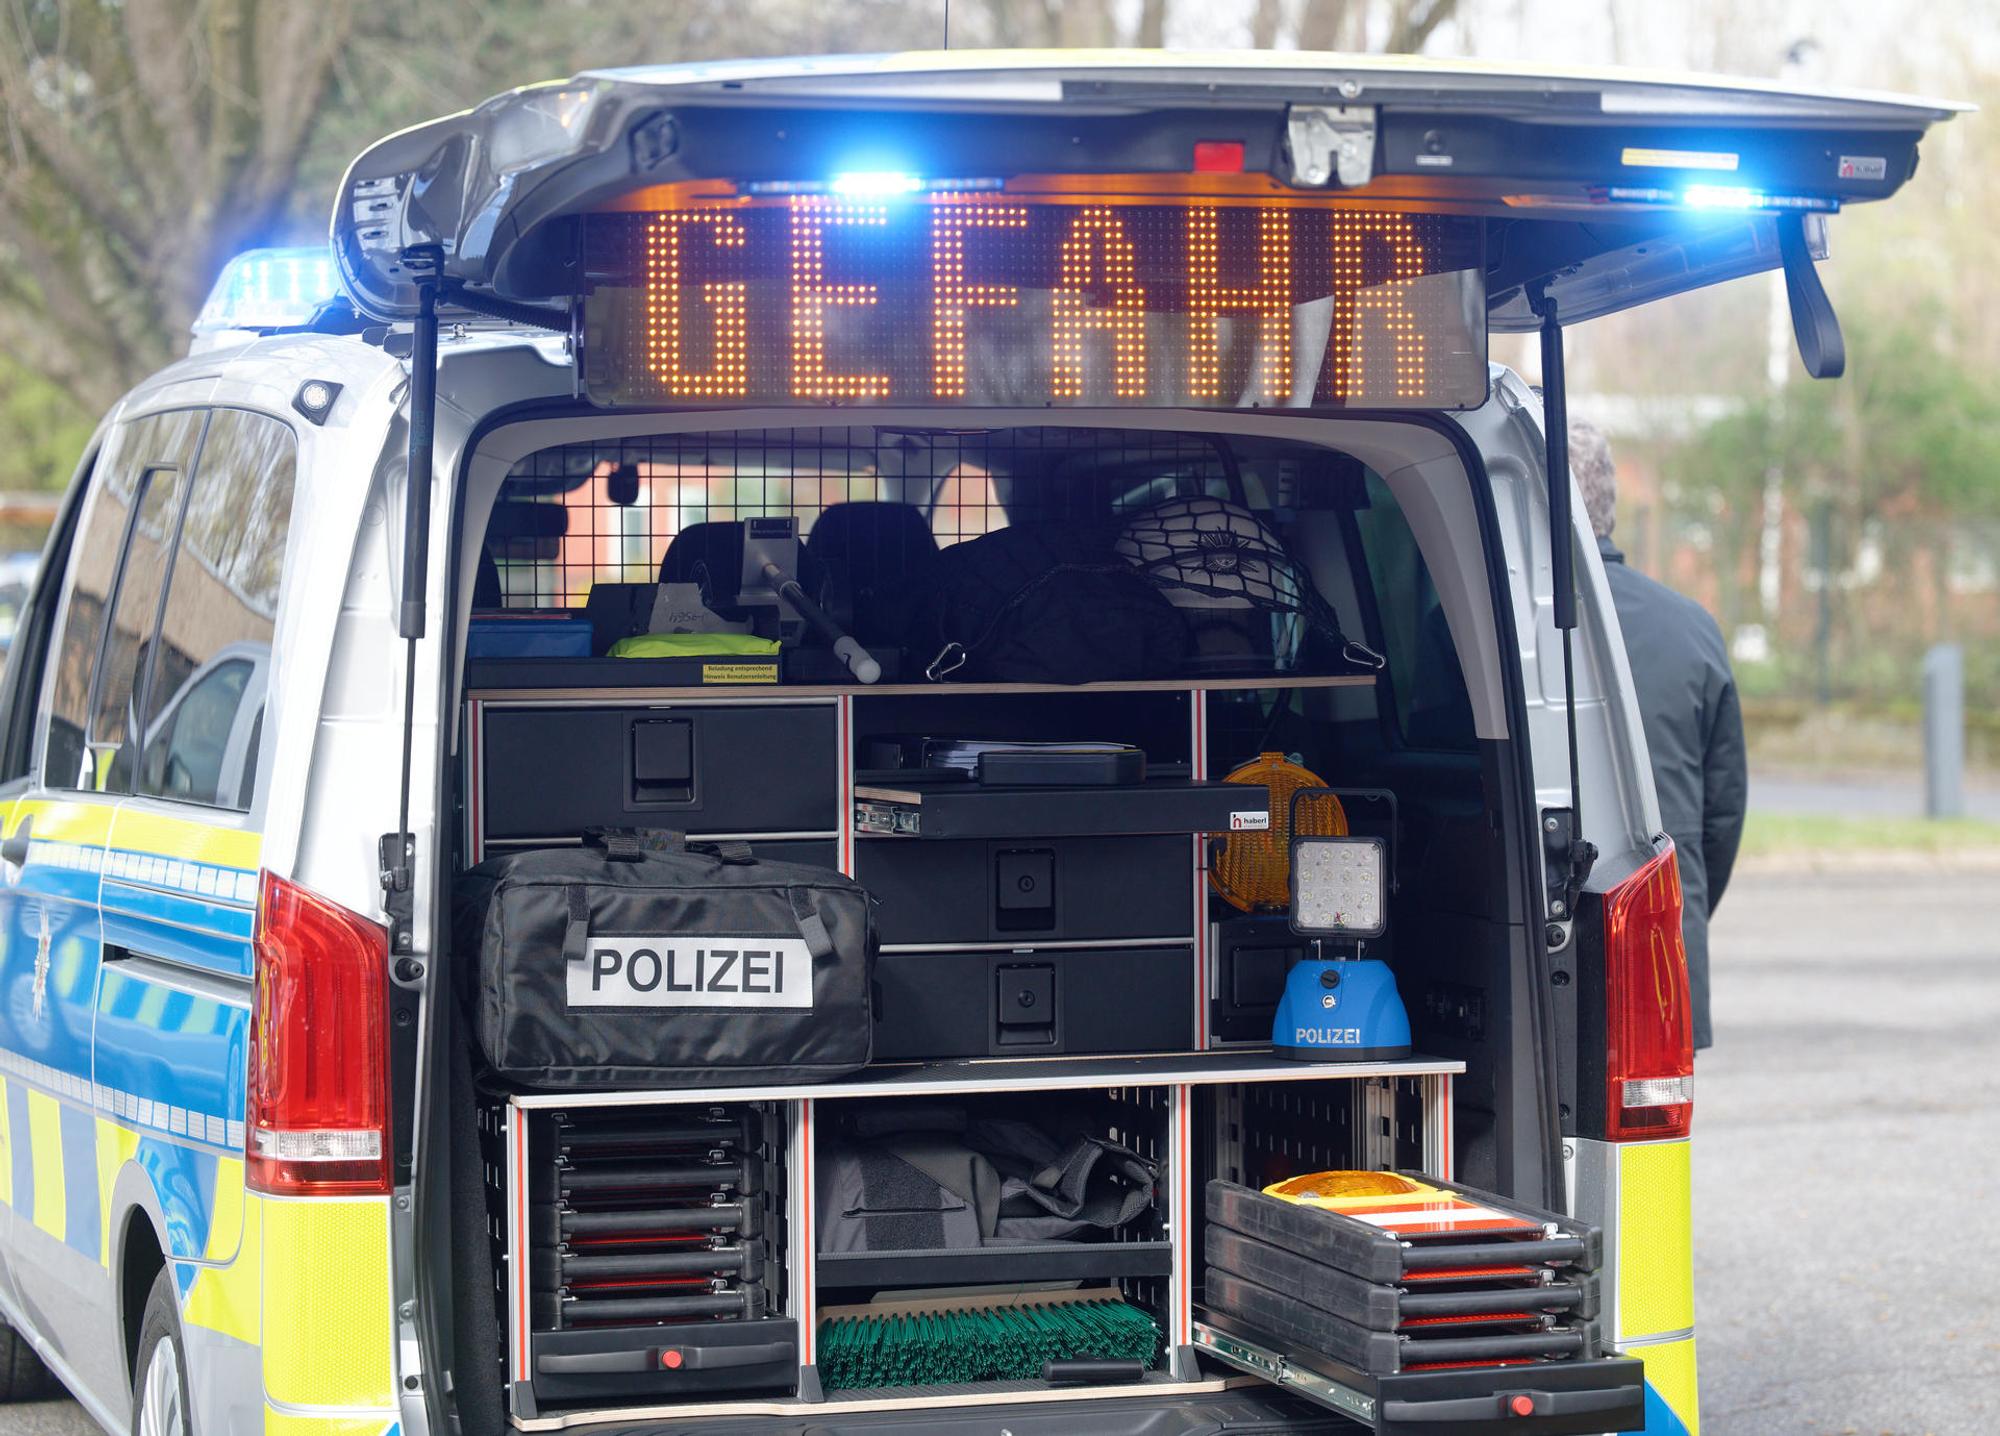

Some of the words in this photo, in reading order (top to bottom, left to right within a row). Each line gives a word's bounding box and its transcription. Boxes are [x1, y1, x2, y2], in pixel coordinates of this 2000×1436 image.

[646, 194, 1424, 396] GEFAHR
[592, 949, 783, 993] POLIZEI
[1296, 1027, 1360, 1044] POLIZEI
